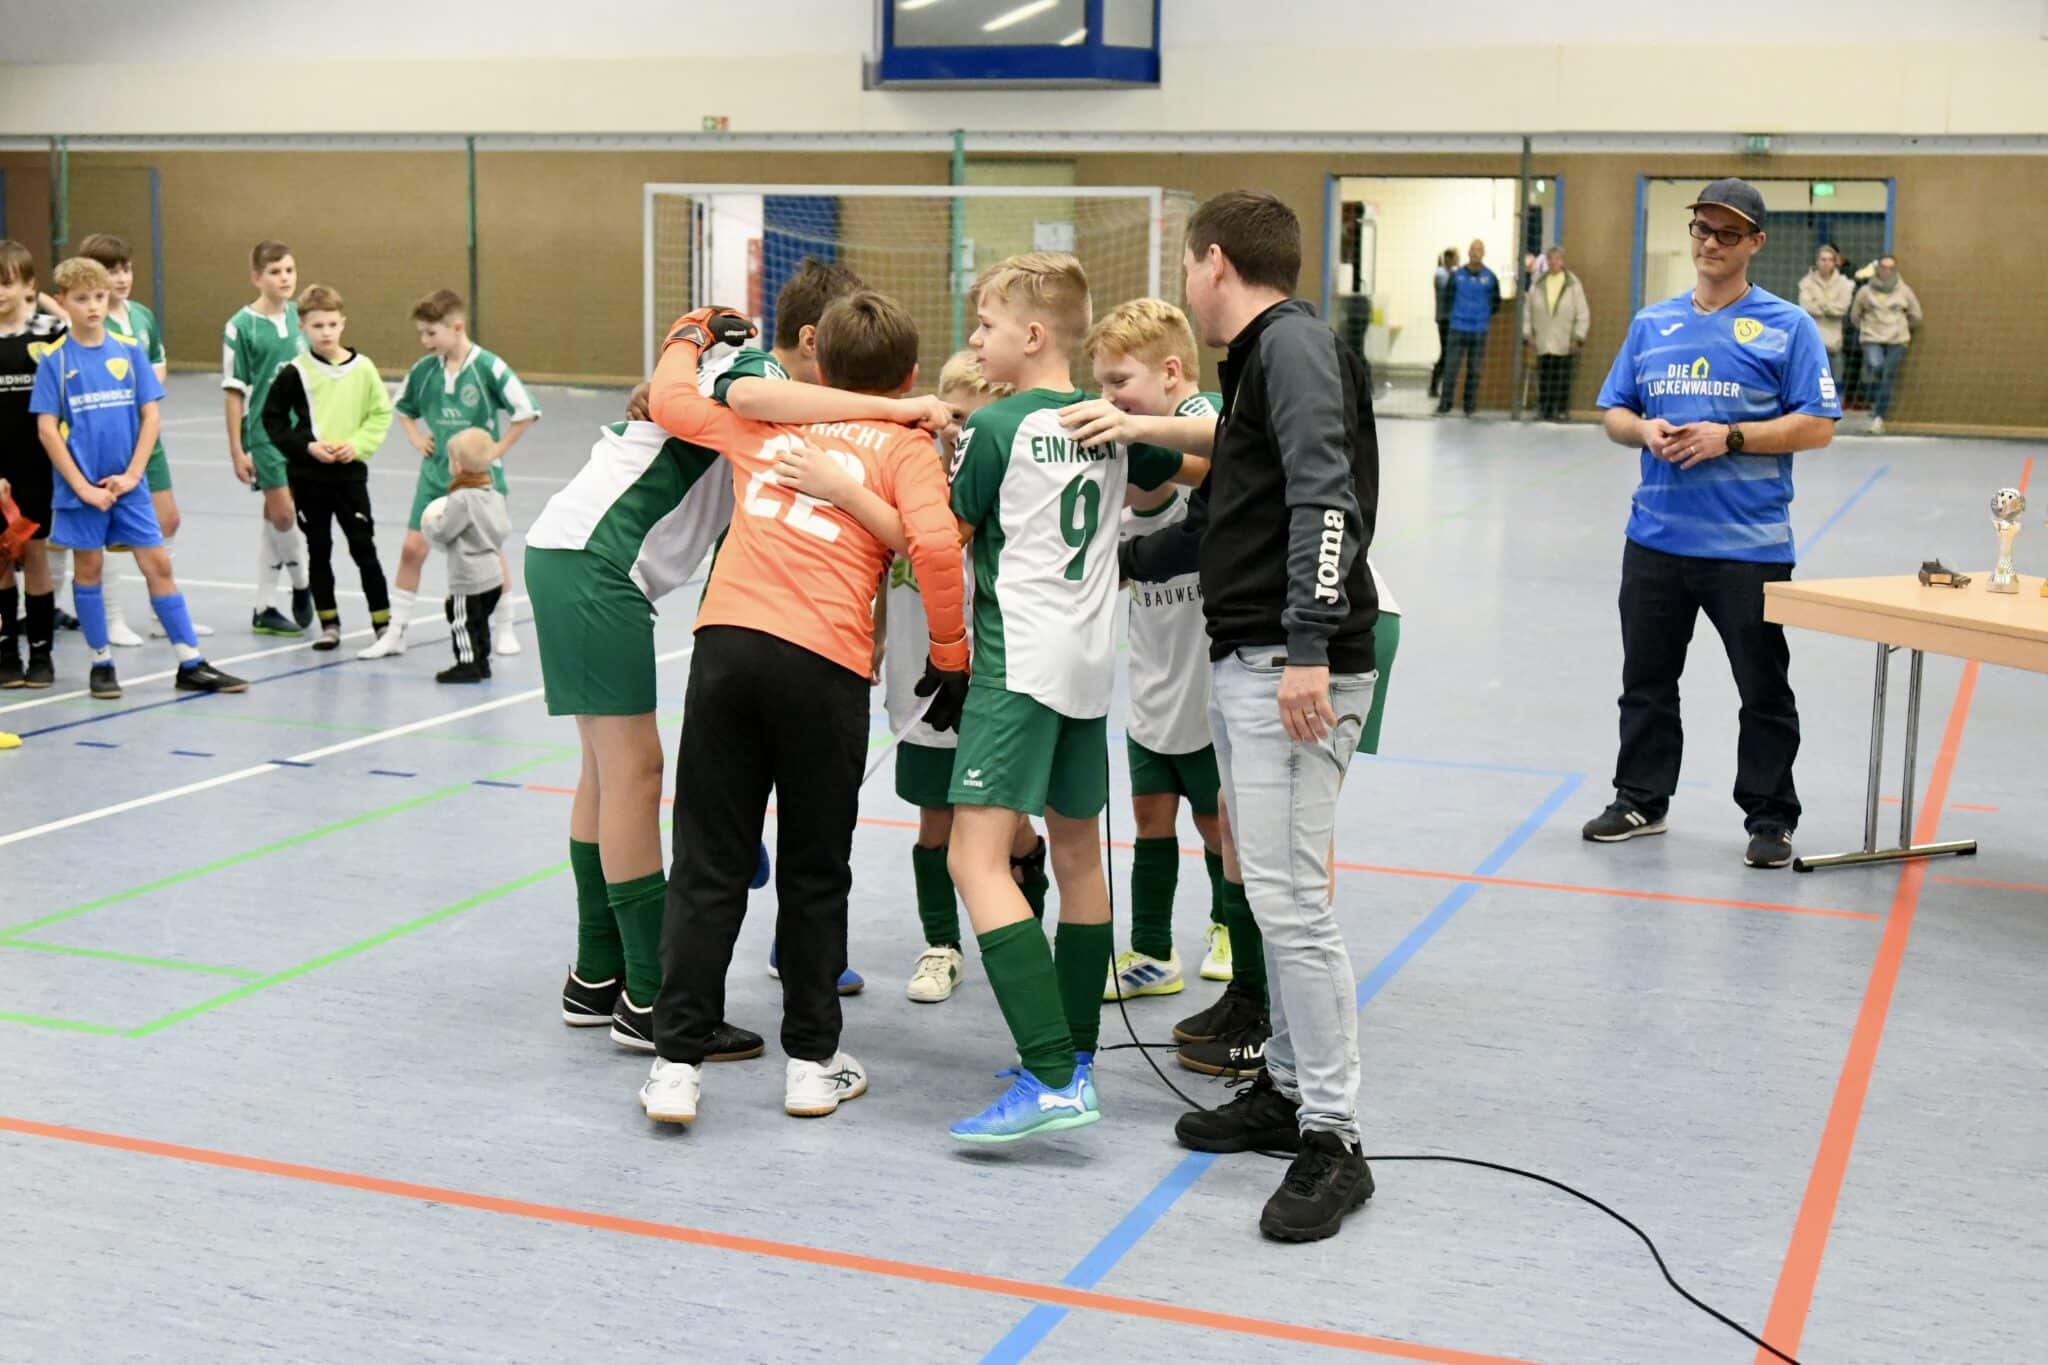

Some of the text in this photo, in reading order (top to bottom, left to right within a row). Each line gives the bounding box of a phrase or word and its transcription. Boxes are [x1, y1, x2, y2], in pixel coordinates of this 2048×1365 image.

[1668, 363, 1690, 379] DIE
[1648, 380, 1740, 398] LUCKENWALDER
[800, 421, 891, 450] RACHT
[743, 432, 866, 543] 22
[1060, 474, 1100, 581] 9
